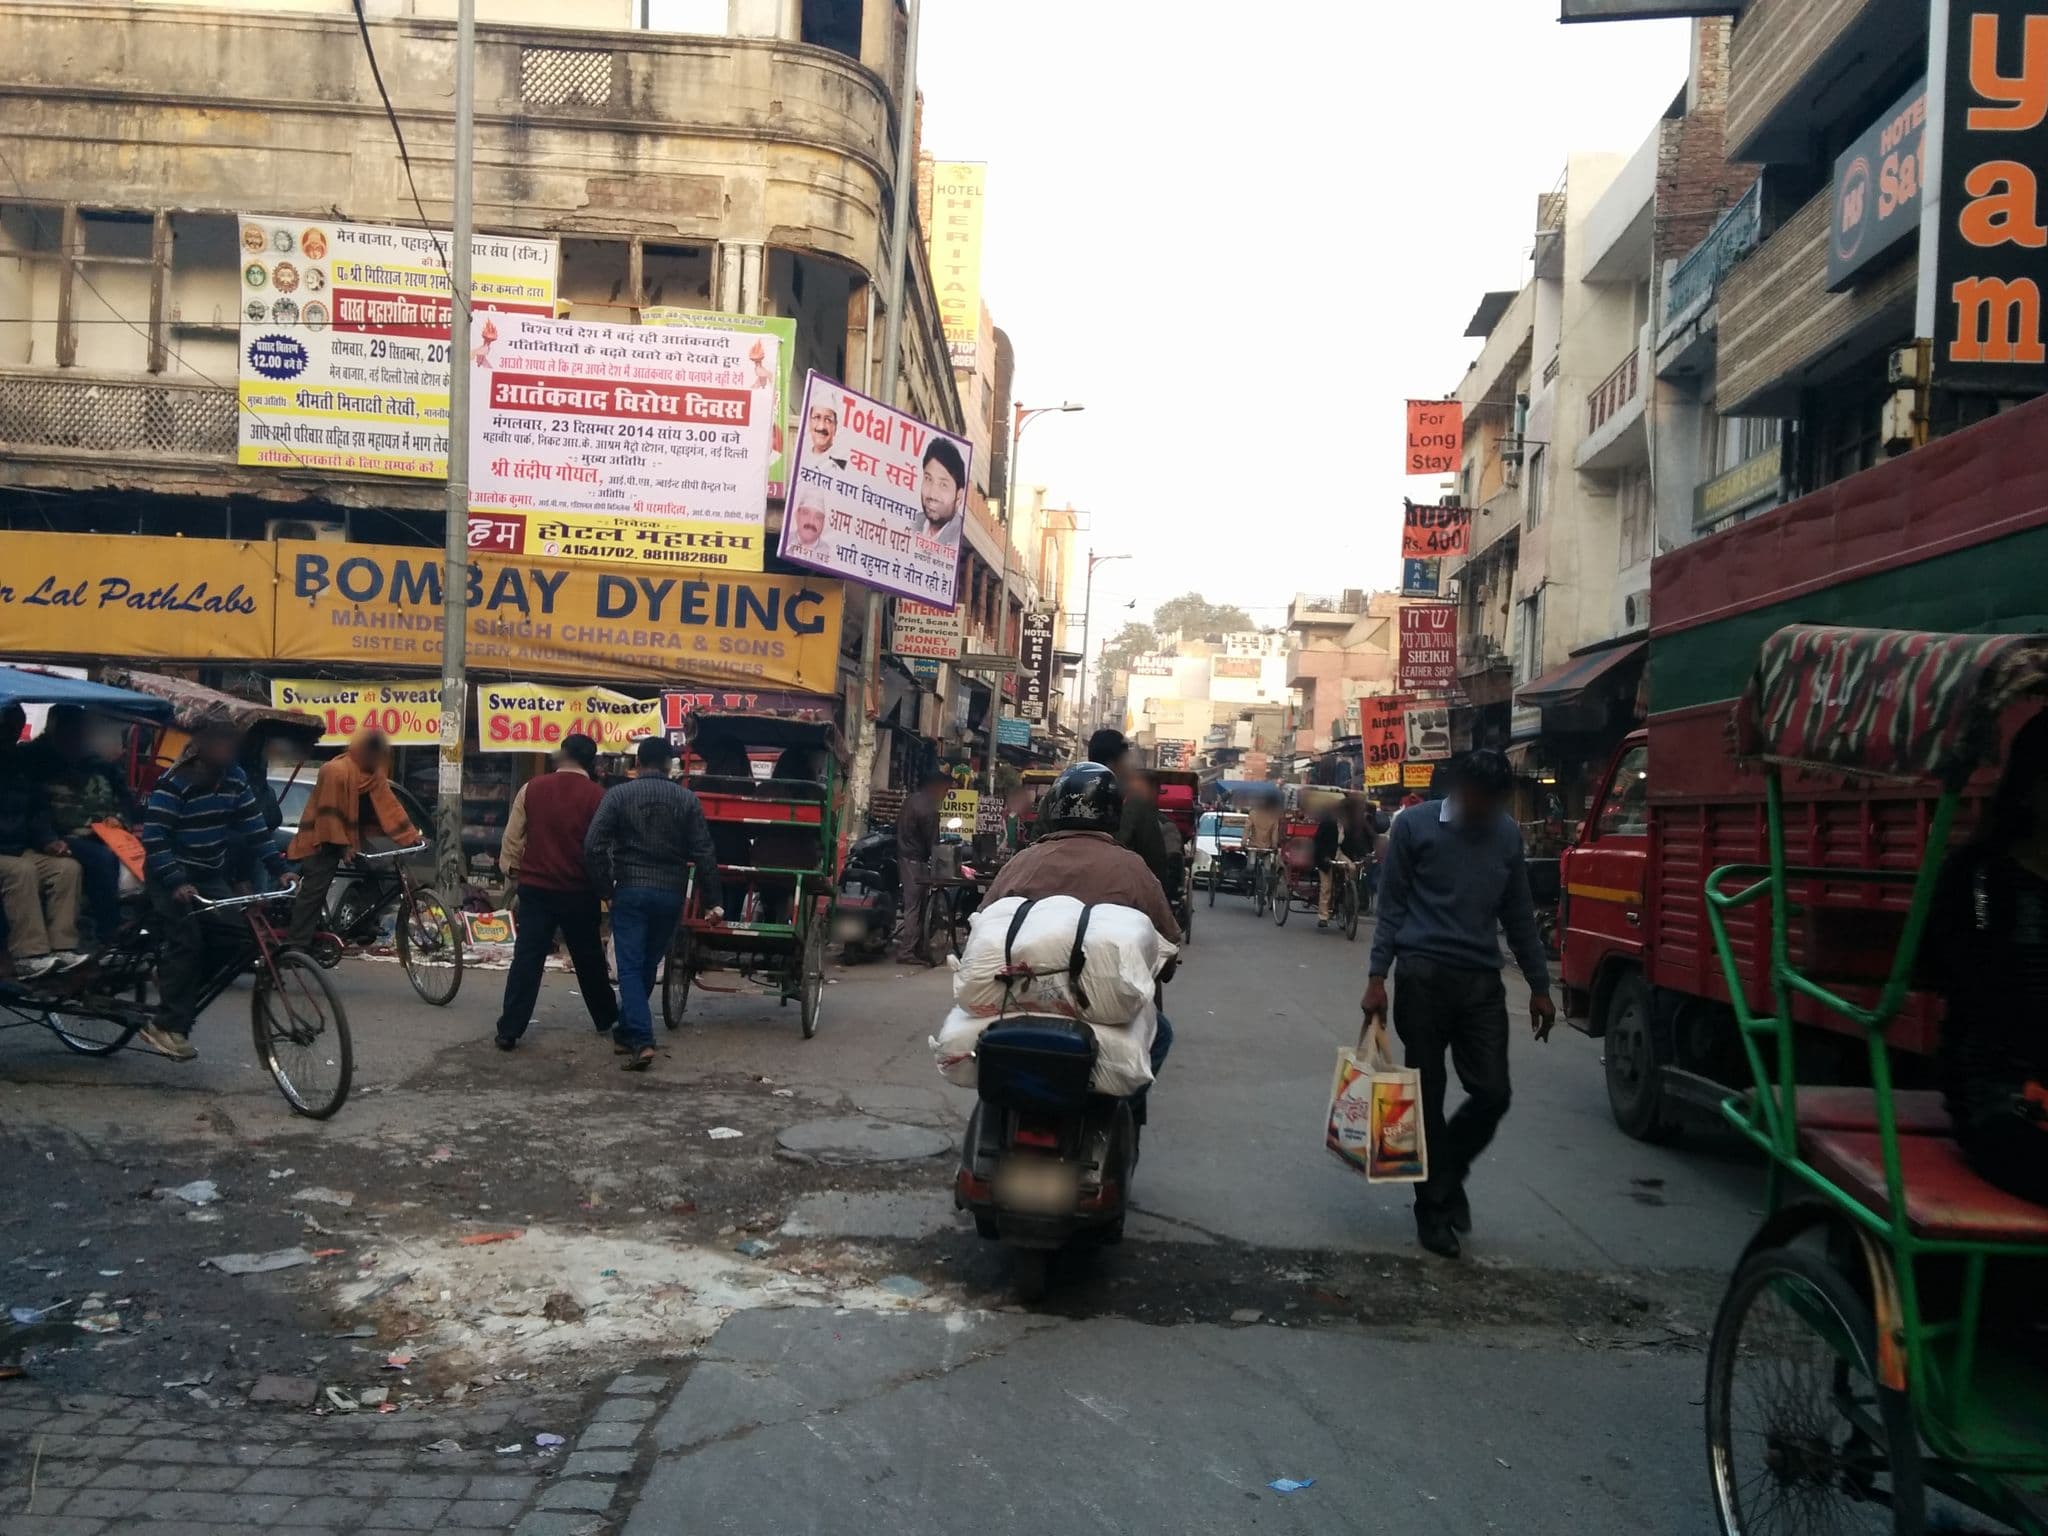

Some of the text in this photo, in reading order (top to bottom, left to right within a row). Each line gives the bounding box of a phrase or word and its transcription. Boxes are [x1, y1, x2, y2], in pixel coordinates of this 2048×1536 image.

[1881, 93, 1927, 155] HOTE
[937, 185, 983, 196] HOTEL
[337, 228, 355, 242] मेन
[941, 199, 971, 326] HERITAGE
[578, 326, 599, 339] देश
[639, 331, 658, 345] रही
[662, 334, 730, 349] आतंकवादी
[944, 329, 975, 341] OME
[370, 339, 387, 358] 29
[253, 355, 281, 368] 12.00
[296, 389, 333, 410] श्रीमती
[496, 381, 746, 420] आतंकवाद विरोध दिवस
[493, 414, 547, 433] मंगलवार,
[552, 420, 569, 432] 23
[573, 420, 614, 436] दिसम्बर
[618, 424, 653, 437] 2014
[686, 429, 716, 443] 3.00
[721, 430, 741, 444] बजे
[842, 396, 927, 458] Total TV
[1419, 413, 1445, 425] For
[294, 423, 323, 444] परिवार
[326, 426, 350, 449] सहित
[1410, 433, 1456, 449] Long
[609, 455, 646, 467] अतिथि
[724, 447, 748, 459] दिल्ली
[1412, 454, 1453, 472] Stay
[491, 458, 603, 486] श्री संदीप गोयल,
[850, 446, 918, 492] का सर्वे
[800, 465, 832, 493] करोल
[835, 476, 859, 499] बाग
[861, 484, 919, 523] विधानसभा
[537, 520, 754, 550] होटल महासंघ
[828, 508, 852, 535] आम
[855, 515, 888, 547] आदमी
[835, 544, 858, 566] भारी
[859, 551, 890, 577] बहुमत
[892, 559, 902, 579] से
[903, 562, 923, 586] जीत
[924, 570, 940, 593] रही
[22, 576, 257, 617] Lal PathLabs
[294, 553, 826, 637] BOMBAY DYEING
[918, 627, 959, 636] Services
[926, 618, 949, 627] Scan
[332, 608, 786, 659] MAHINDE SINGH CHHABRA & SONS
[904, 635, 950, 646] MONEY
[1024, 630, 1052, 638] HOTEL
[351, 634, 418, 652] SISTER
[422, 639, 513, 660] COCERN
[675, 656, 765, 676] SERVICES
[895, 644, 957, 657] CHANGER
[1408, 650, 1449, 663] SHEIKH
[1028, 637, 1043, 701] HERITAGE
[1137, 667, 1168, 675] HOTEL
[1401, 665, 1455, 678] LEATHER SHOP
[282, 687, 359, 704] Sweater
[489, 693, 658, 715] Sweater Sweater
[363, 708, 422, 736] 40%
[489, 713, 561, 744] Sale
[943, 801, 975, 811] URIST
